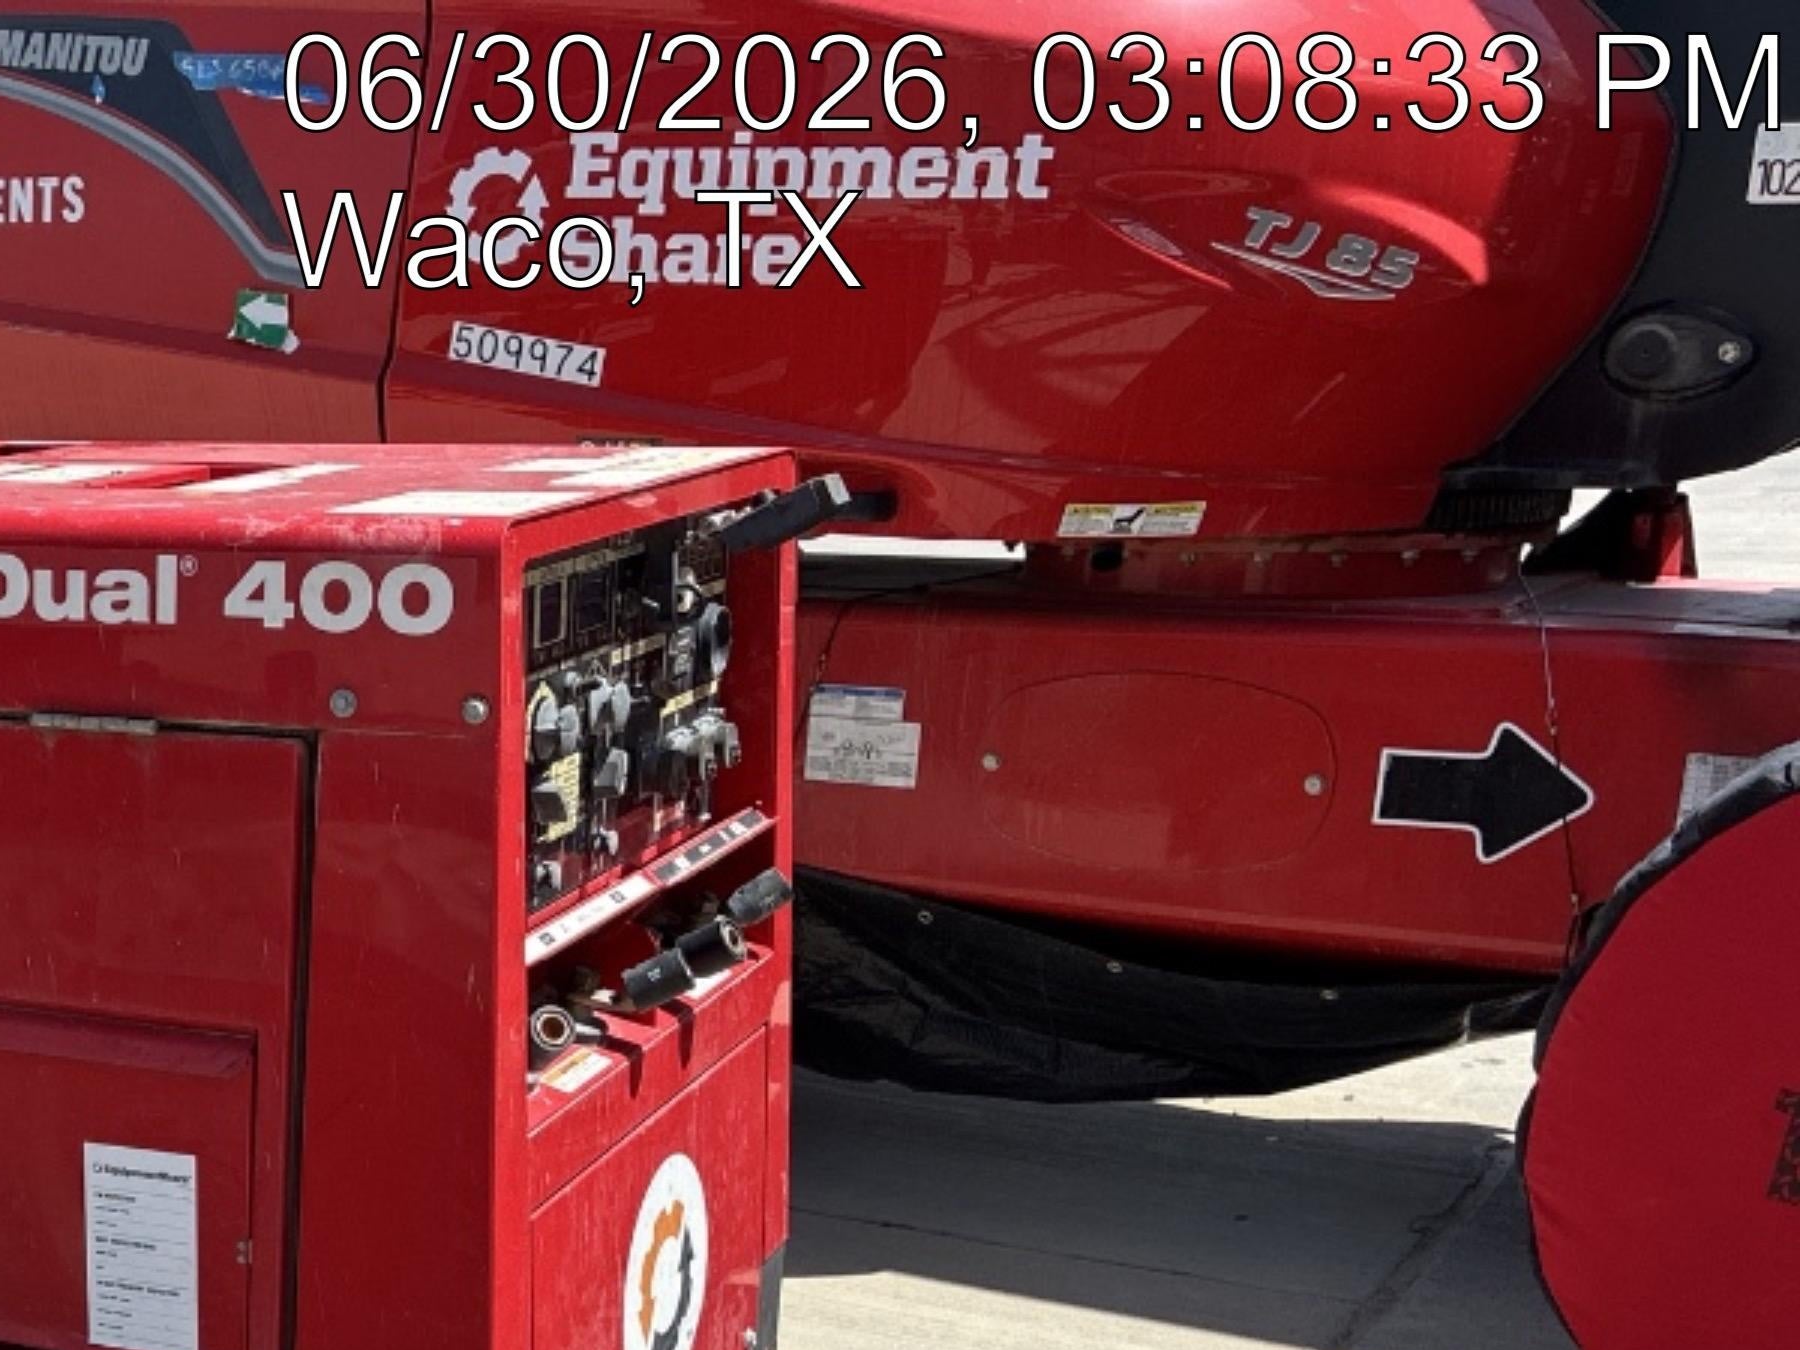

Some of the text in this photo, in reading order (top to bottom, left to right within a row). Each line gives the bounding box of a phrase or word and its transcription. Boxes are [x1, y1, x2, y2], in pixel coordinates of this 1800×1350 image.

[564, 132, 1055, 217] Equipment
[1244, 206, 1420, 289] TJ 85
[452, 325, 598, 382] 509974
[222, 558, 455, 636] 400
